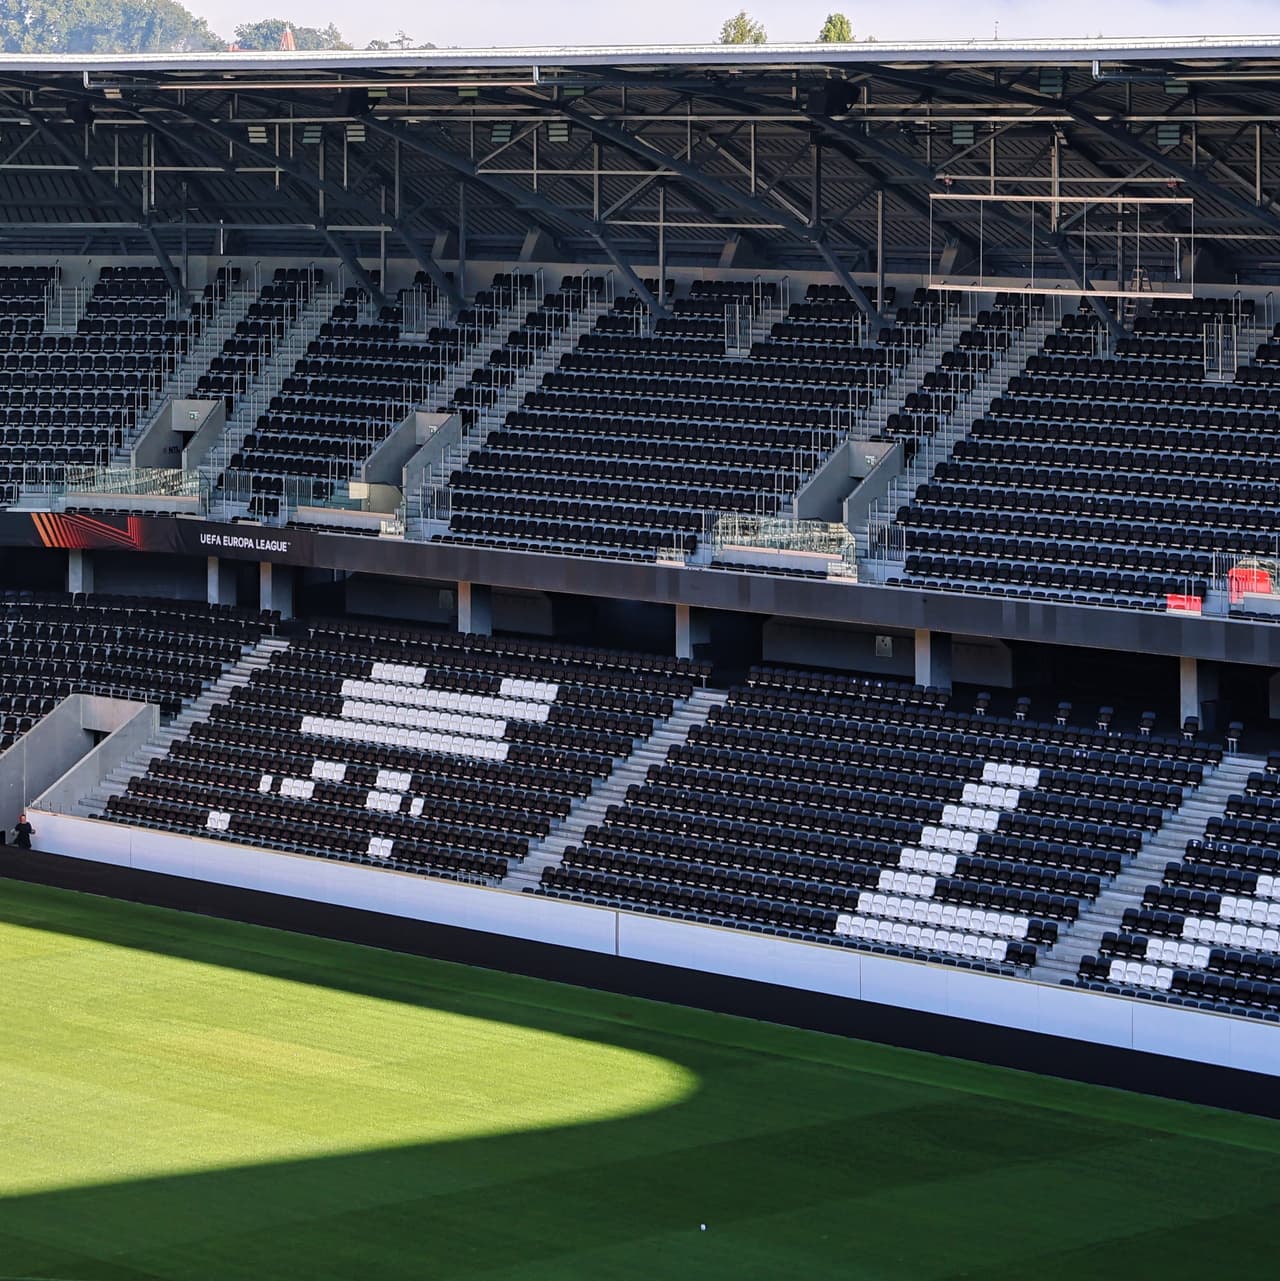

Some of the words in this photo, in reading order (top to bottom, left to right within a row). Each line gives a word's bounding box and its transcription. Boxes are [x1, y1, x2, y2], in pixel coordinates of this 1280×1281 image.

[200, 533, 221, 546] UEFA
[223, 535, 254, 549] EUROPA
[256, 539, 287, 552] LEAGUE
